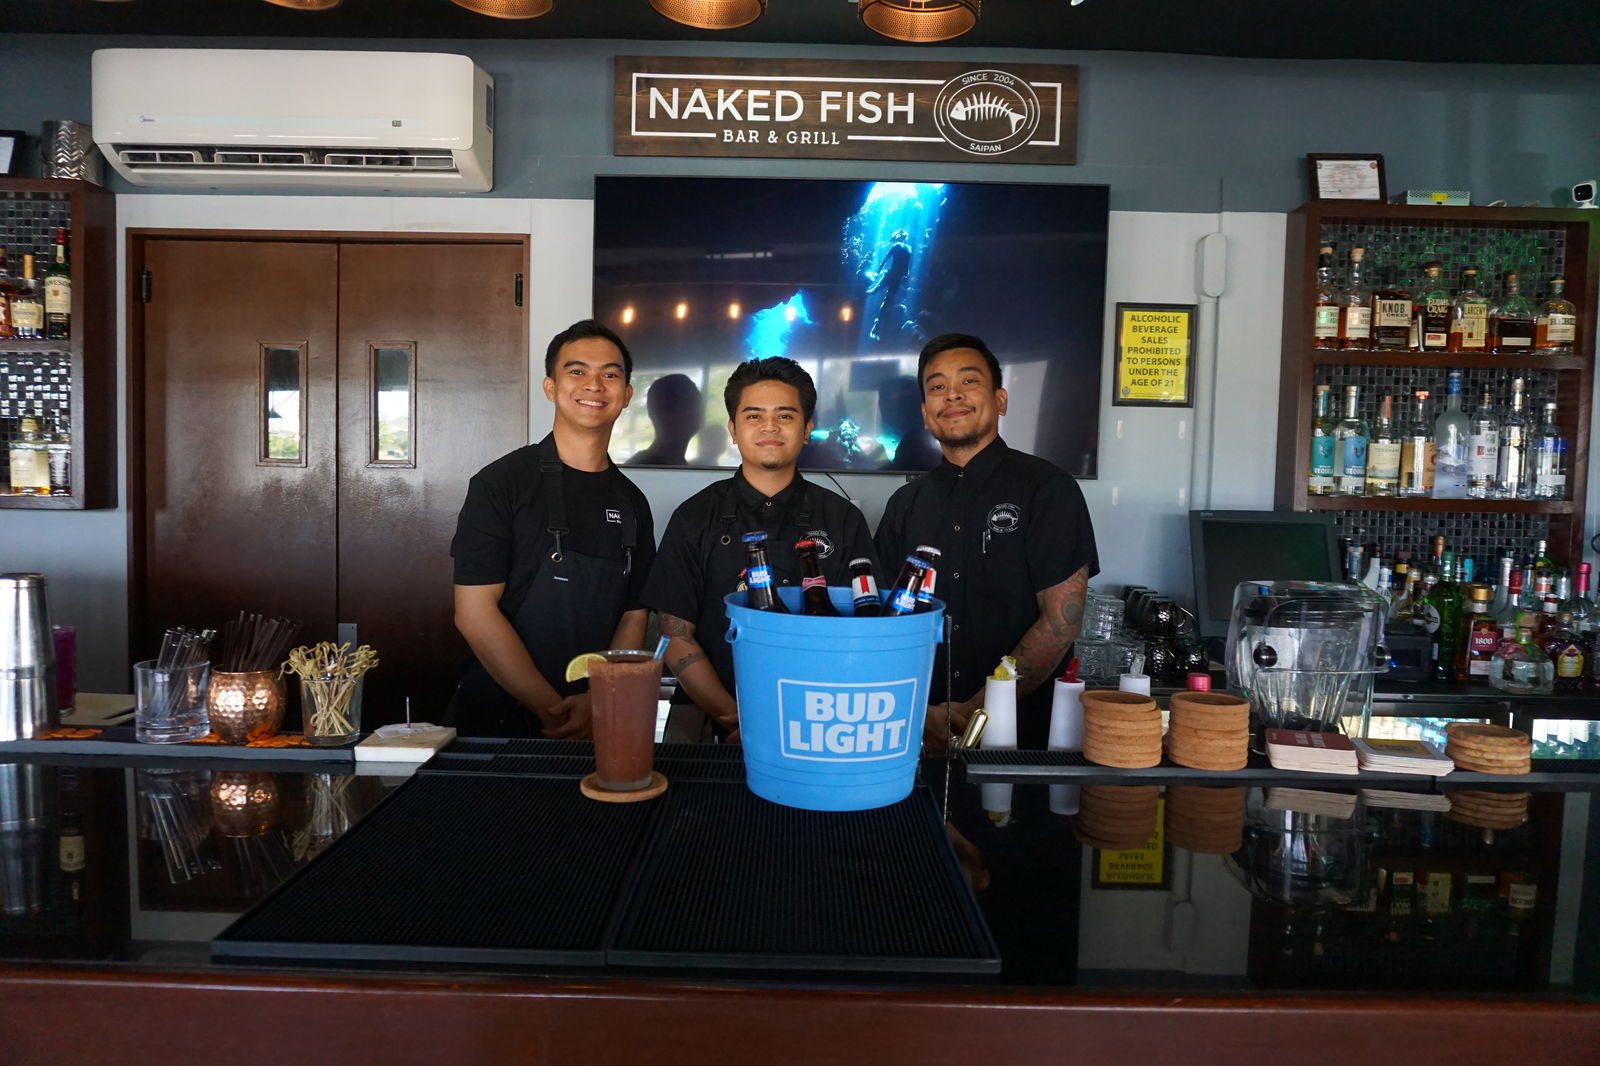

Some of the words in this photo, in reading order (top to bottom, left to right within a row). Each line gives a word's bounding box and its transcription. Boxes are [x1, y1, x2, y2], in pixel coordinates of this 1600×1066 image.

[962, 73, 988, 85] SINCE
[993, 74, 1015, 86] 2004
[649, 87, 804, 122] NAKED
[820, 90, 915, 124] FISH
[723, 129, 760, 144] BAR
[768, 130, 779, 144] &
[786, 130, 840, 145] GRILL
[970, 143, 1002, 152] SAIPAN
[1382, 303, 1406, 313] KNOB
[1130, 314, 1182, 323] ALCOHOLIC
[1132, 326, 1178, 334] BEVERAGE
[1128, 347, 1181, 355] PROHIBITED
[1140, 358, 1181, 366] PERSONS
[749, 576, 771, 584] LIGHT
[805, 690, 896, 722] BUD
[789, 720, 906, 754] LIGHT
